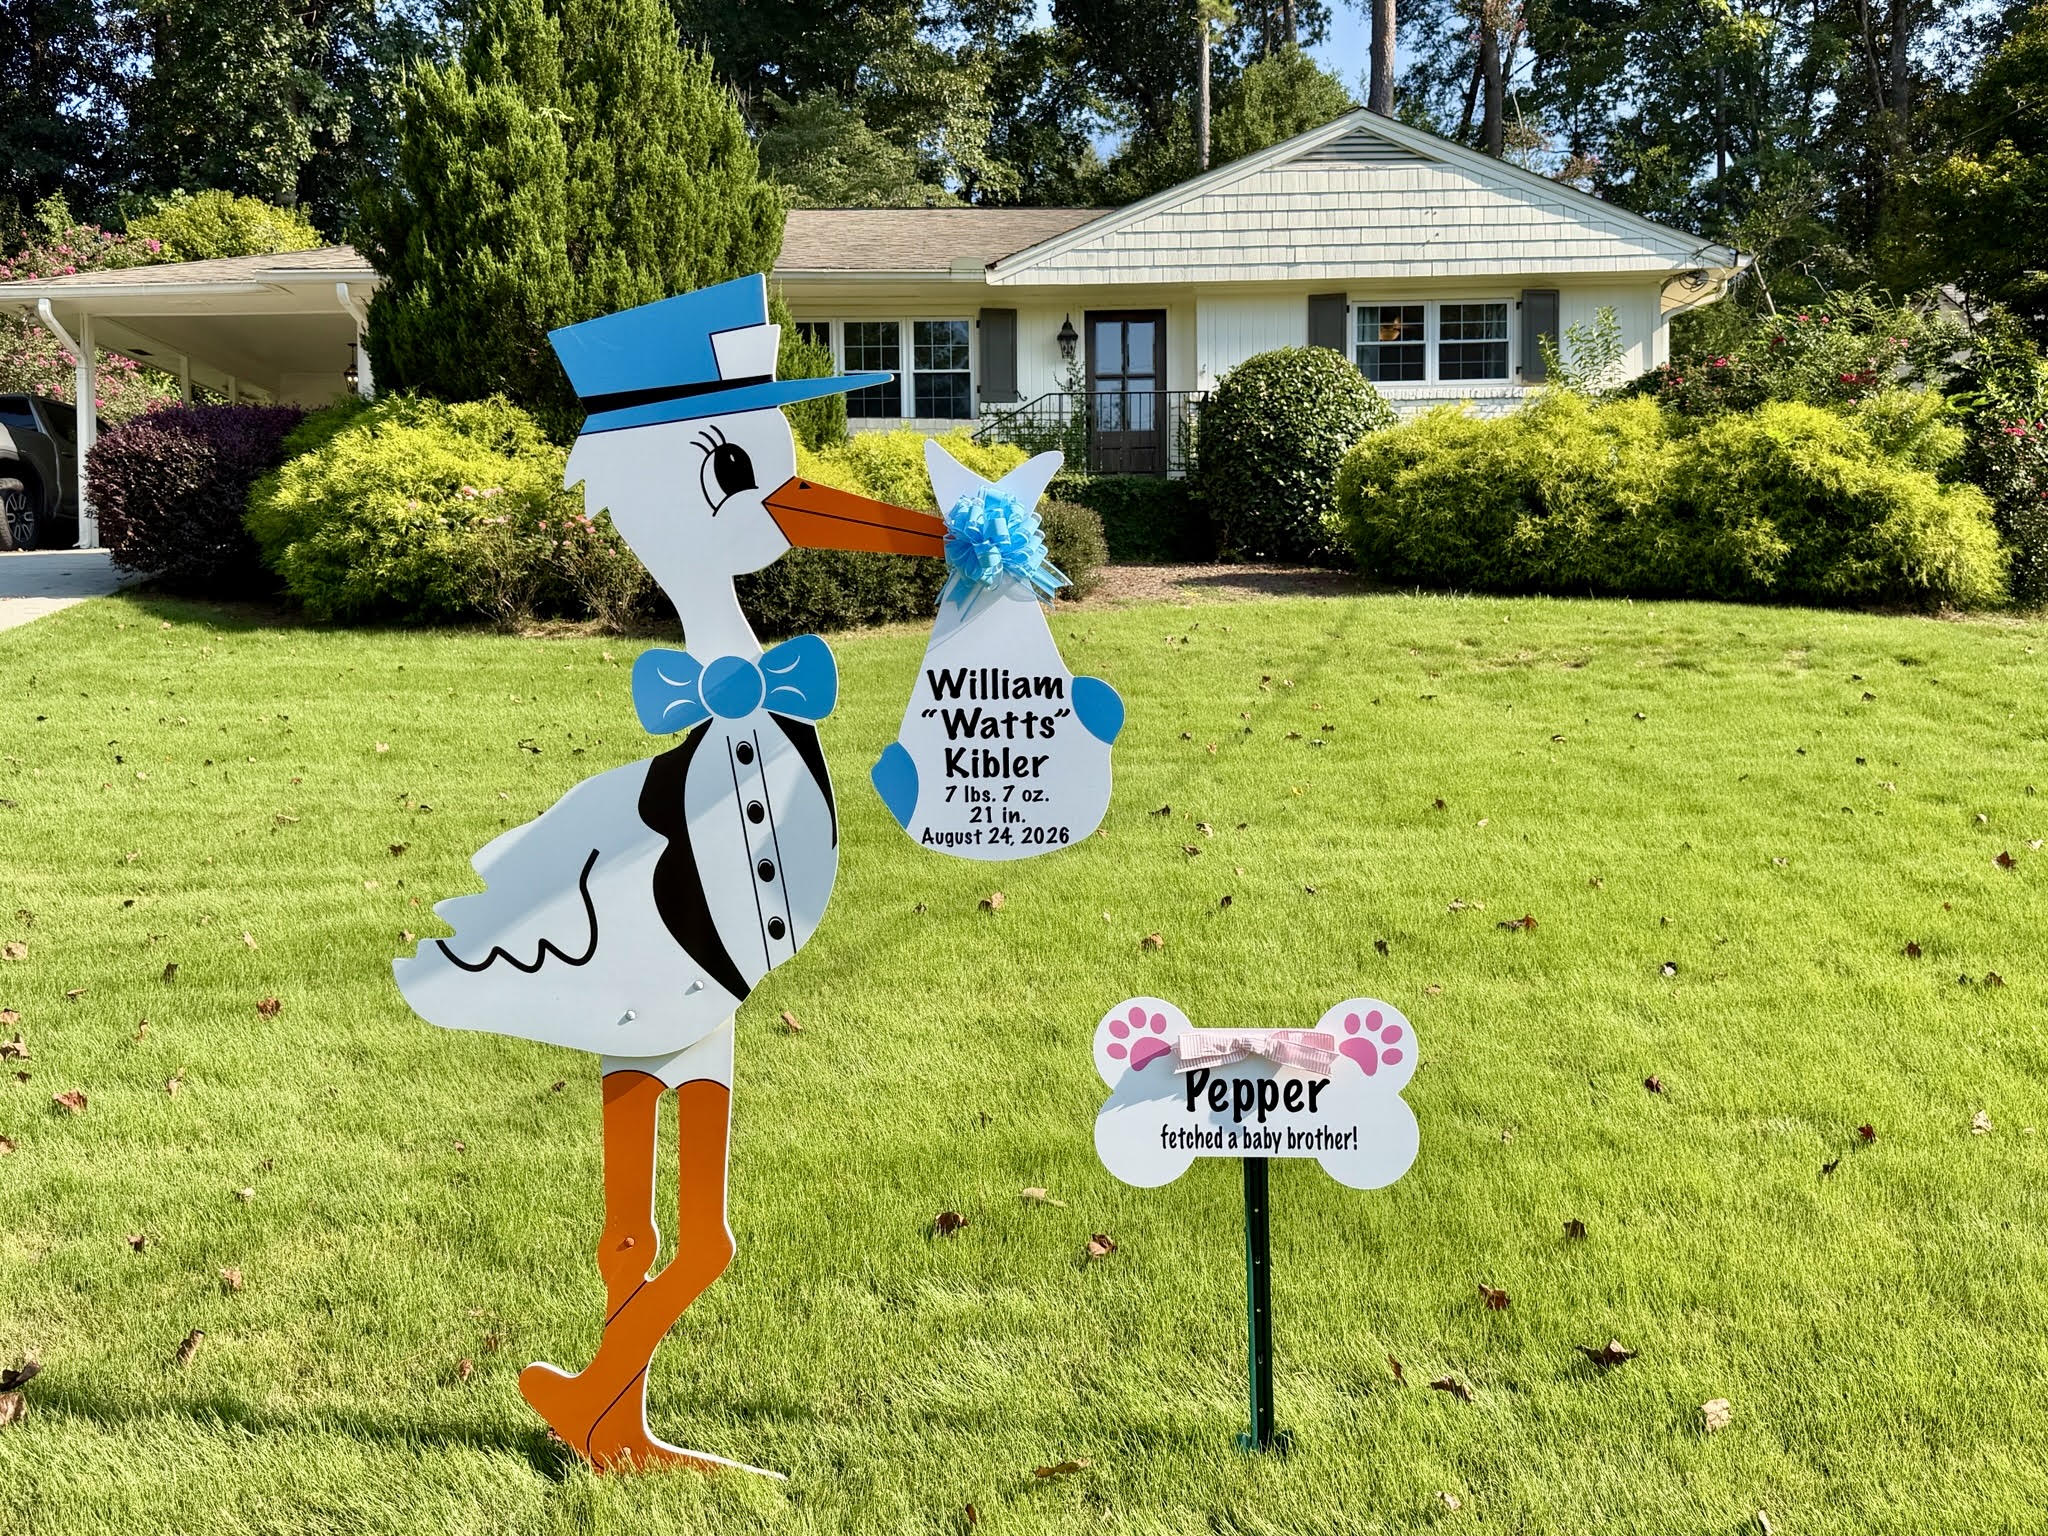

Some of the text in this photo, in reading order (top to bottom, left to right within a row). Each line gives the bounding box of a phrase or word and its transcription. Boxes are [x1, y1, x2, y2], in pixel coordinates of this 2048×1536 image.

[926, 667, 1065, 701] William
[944, 746, 1050, 778] Kibler
[945, 784, 1050, 803] 7 lbs. 7 oz.
[969, 805, 1026, 824] 21 in.
[921, 826, 1070, 848] August 24, 2026
[1185, 1067, 1331, 1123] Pepper
[1160, 1123, 1358, 1154] fetched a baby brother!
